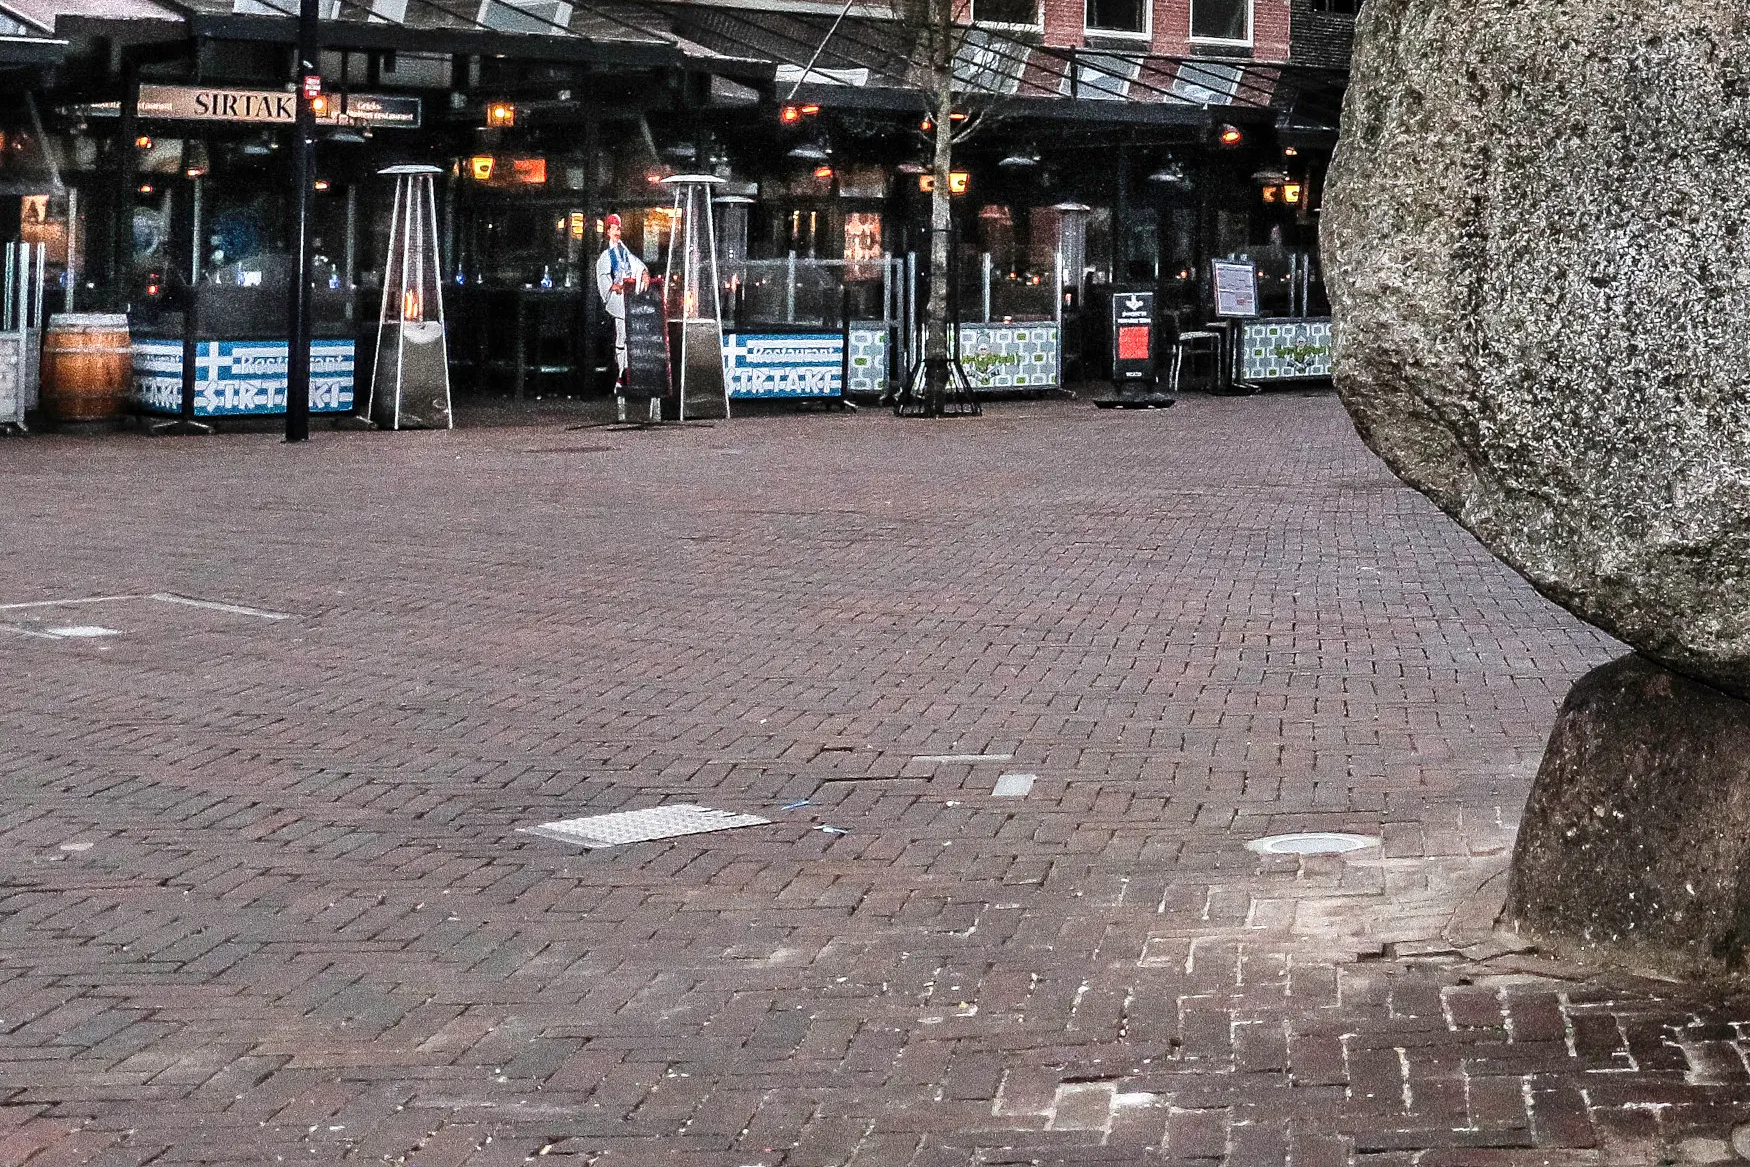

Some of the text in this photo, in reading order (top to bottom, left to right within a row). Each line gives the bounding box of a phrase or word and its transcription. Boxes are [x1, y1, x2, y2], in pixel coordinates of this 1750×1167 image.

[194, 92, 292, 118] SIRTAK
[753, 345, 835, 363] Restaurant
[726, 366, 832, 397] SIRTAKI
